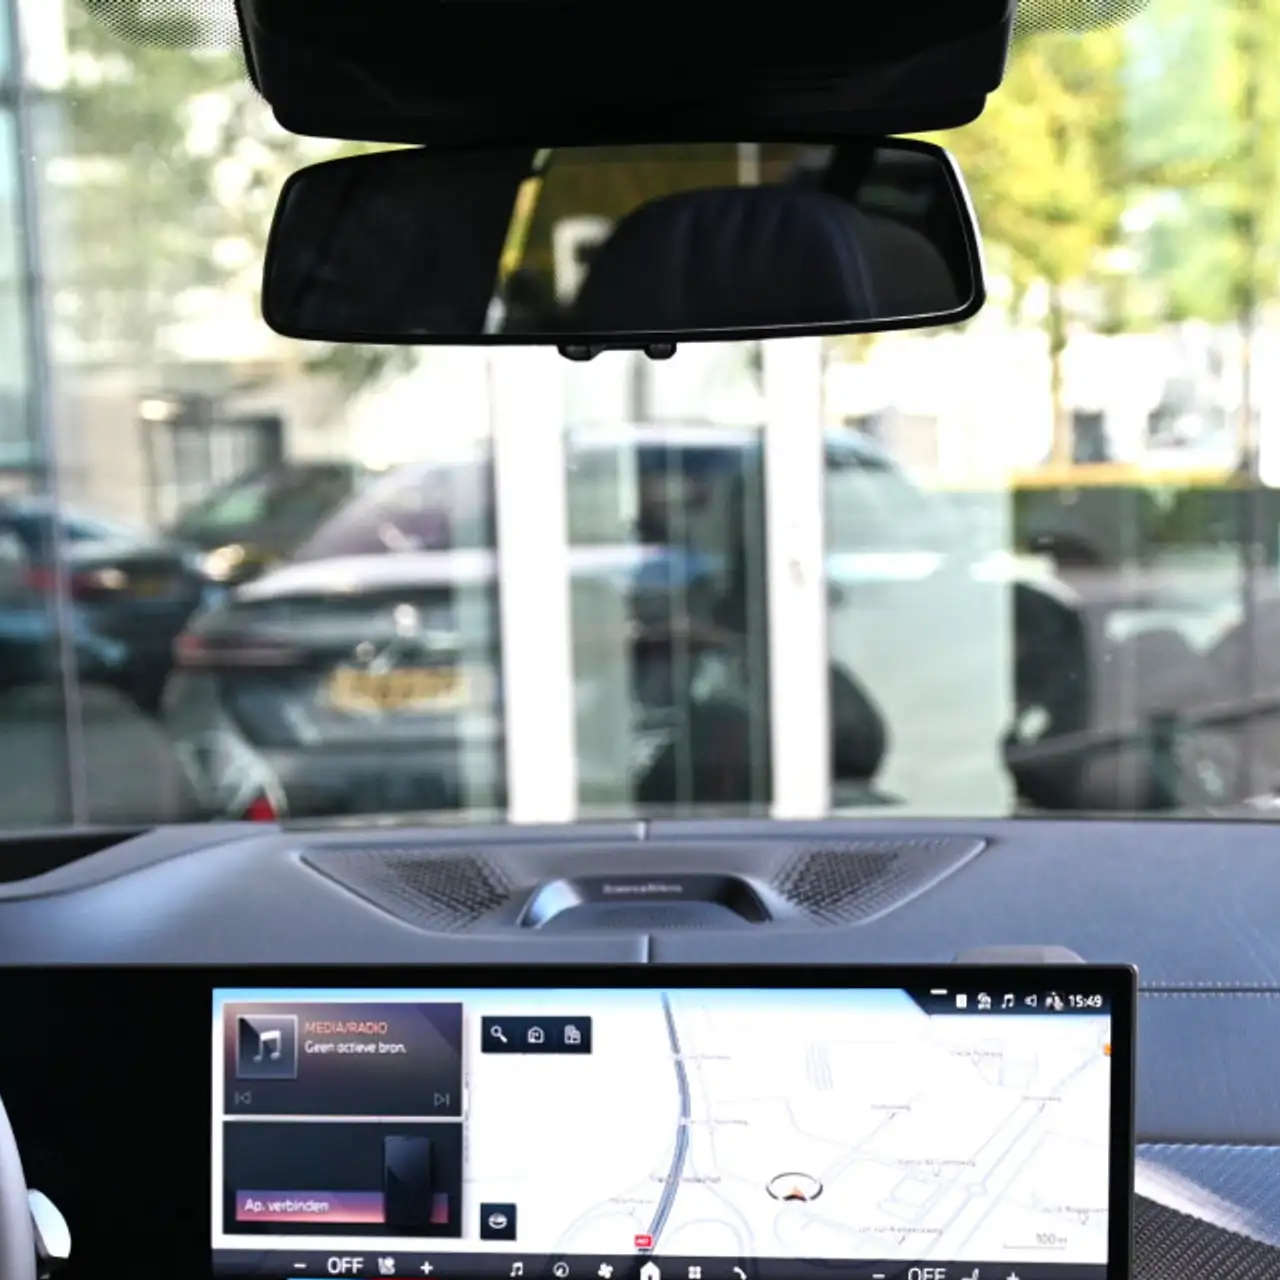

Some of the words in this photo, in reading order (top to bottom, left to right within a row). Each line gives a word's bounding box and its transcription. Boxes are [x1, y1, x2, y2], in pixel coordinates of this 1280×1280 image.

[1068, 995, 1103, 1008] 15:49
[303, 1021, 388, 1035] MEDIA/RADIO
[304, 1040, 334, 1054] Geen
[336, 1040, 376, 1054] actieve
[377, 1040, 406, 1054] bron.
[268, 1199, 329, 1213] verbinden
[327, 1257, 364, 1275] OFF
